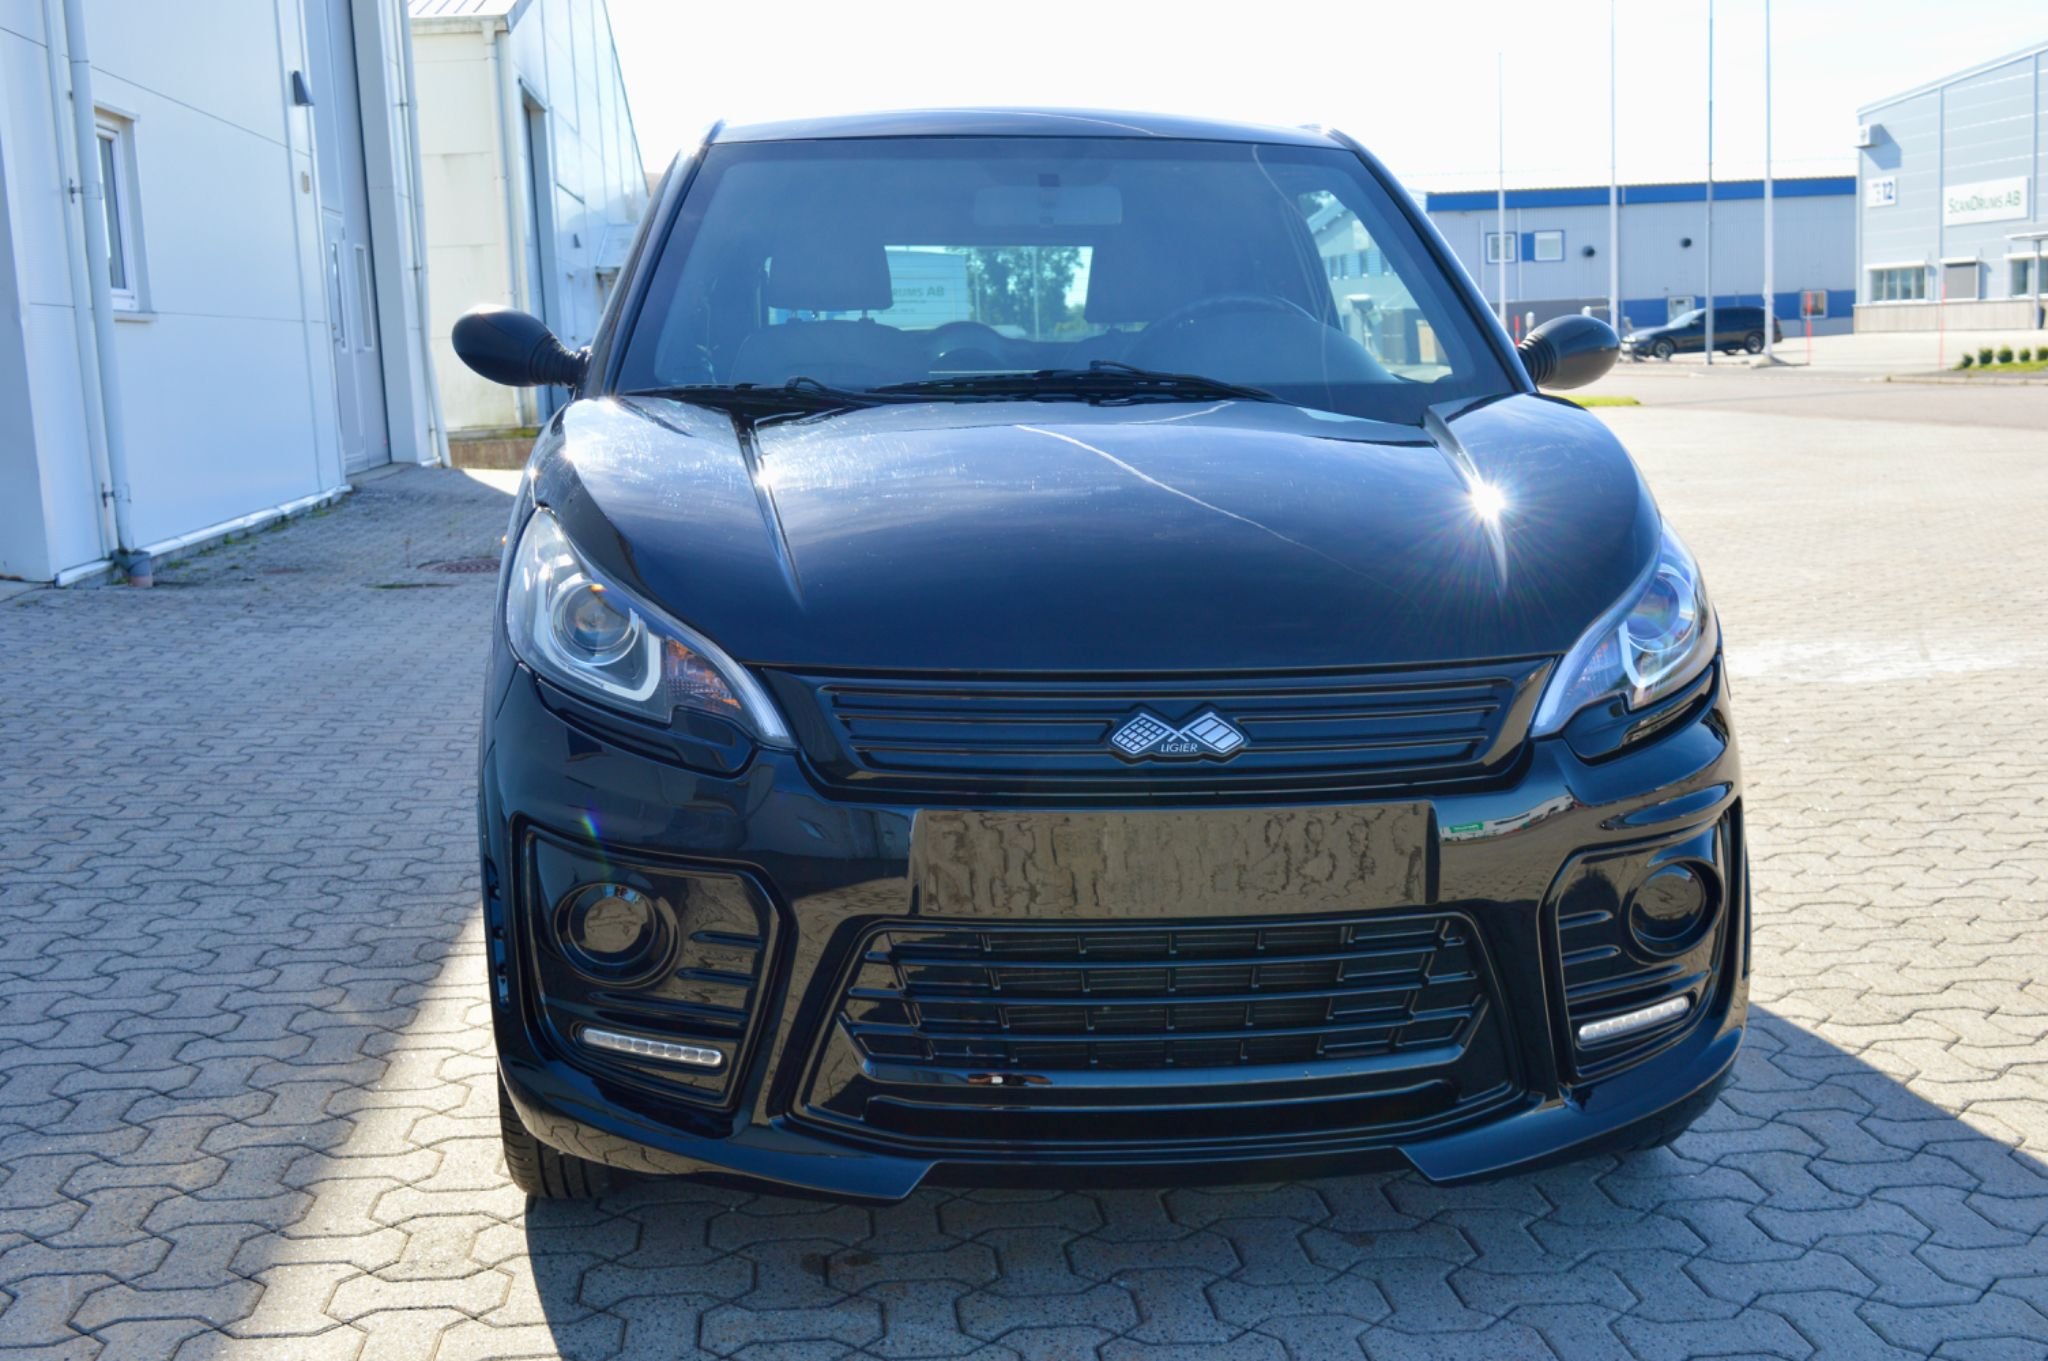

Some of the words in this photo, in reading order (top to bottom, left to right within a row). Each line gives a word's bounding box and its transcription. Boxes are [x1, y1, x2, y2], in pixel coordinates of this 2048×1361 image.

[2005, 189, 2022, 208] AB
[926, 285, 945, 298] AB
[1160, 742, 1198, 753] LIGIER
